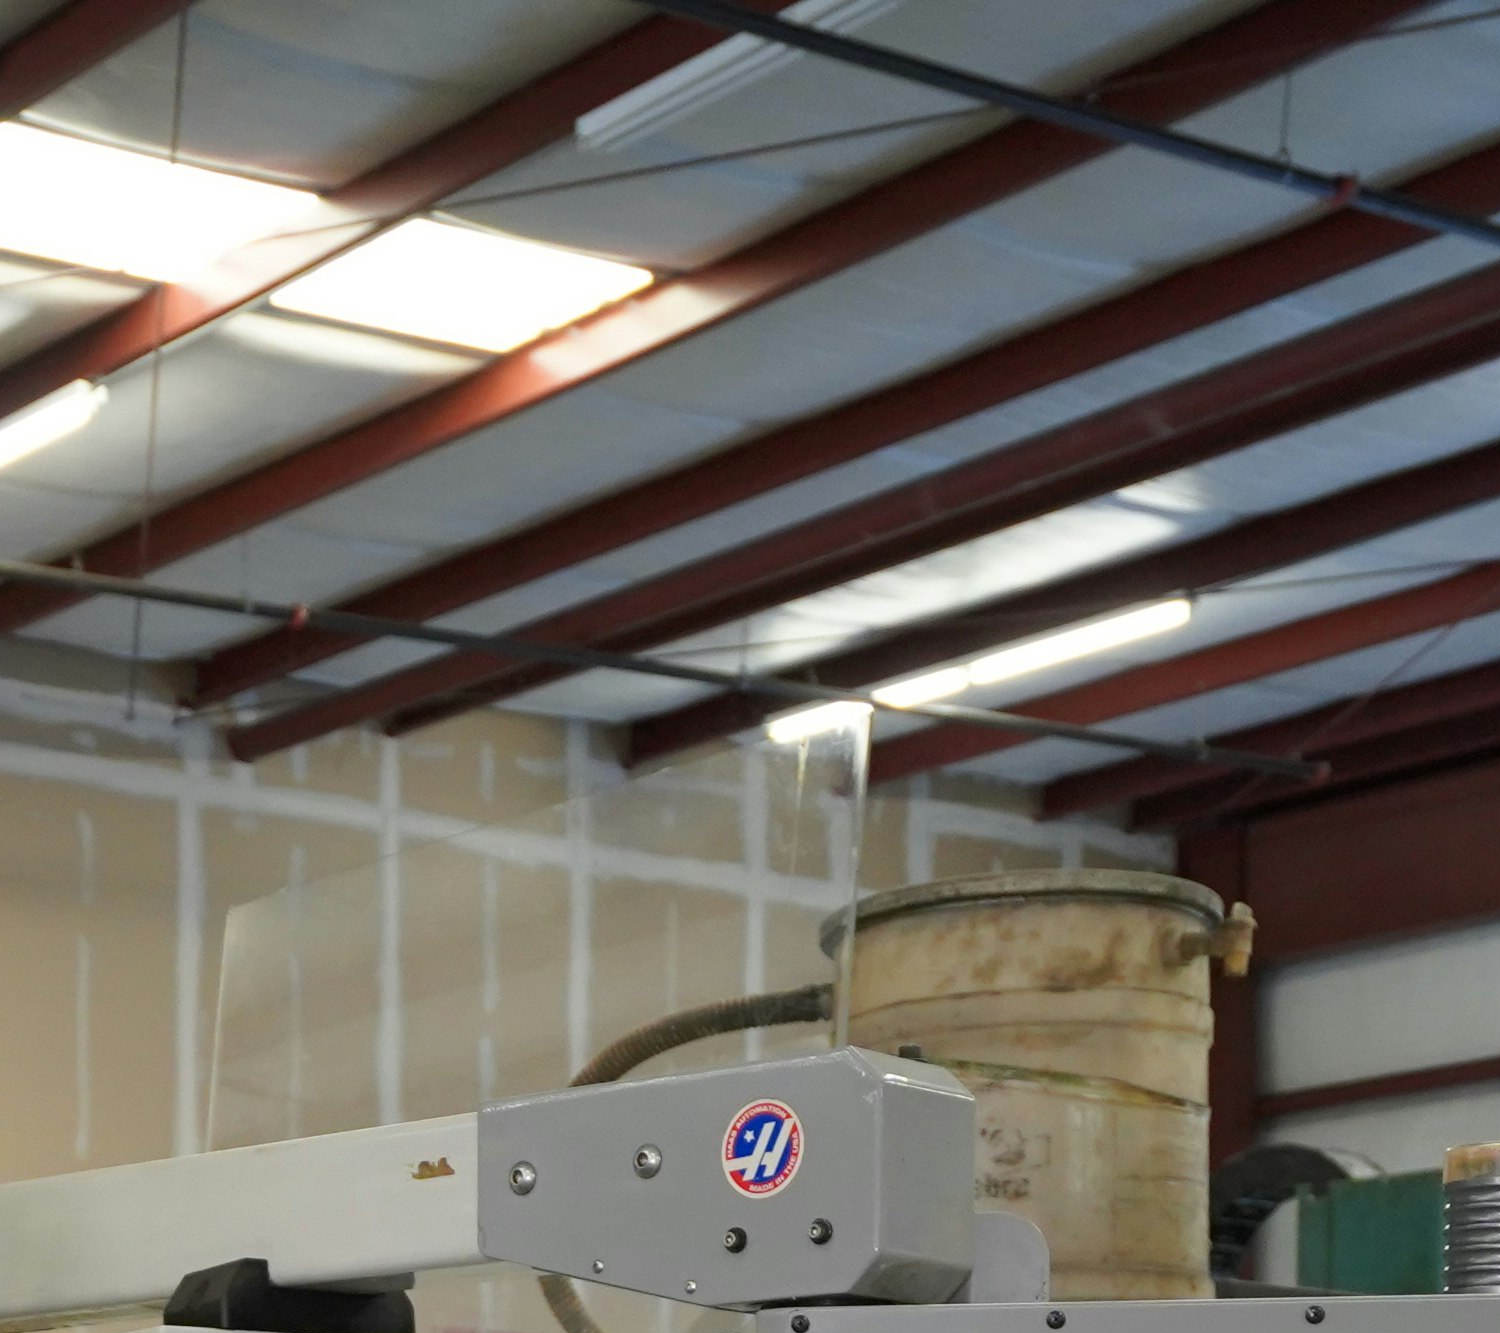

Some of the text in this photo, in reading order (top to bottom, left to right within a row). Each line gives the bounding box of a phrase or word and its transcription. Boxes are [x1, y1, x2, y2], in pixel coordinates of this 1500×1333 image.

[749, 1183, 774, 1192] MADE
[775, 1175, 785, 1184] IN
[786, 1155, 797, 1175] THE
